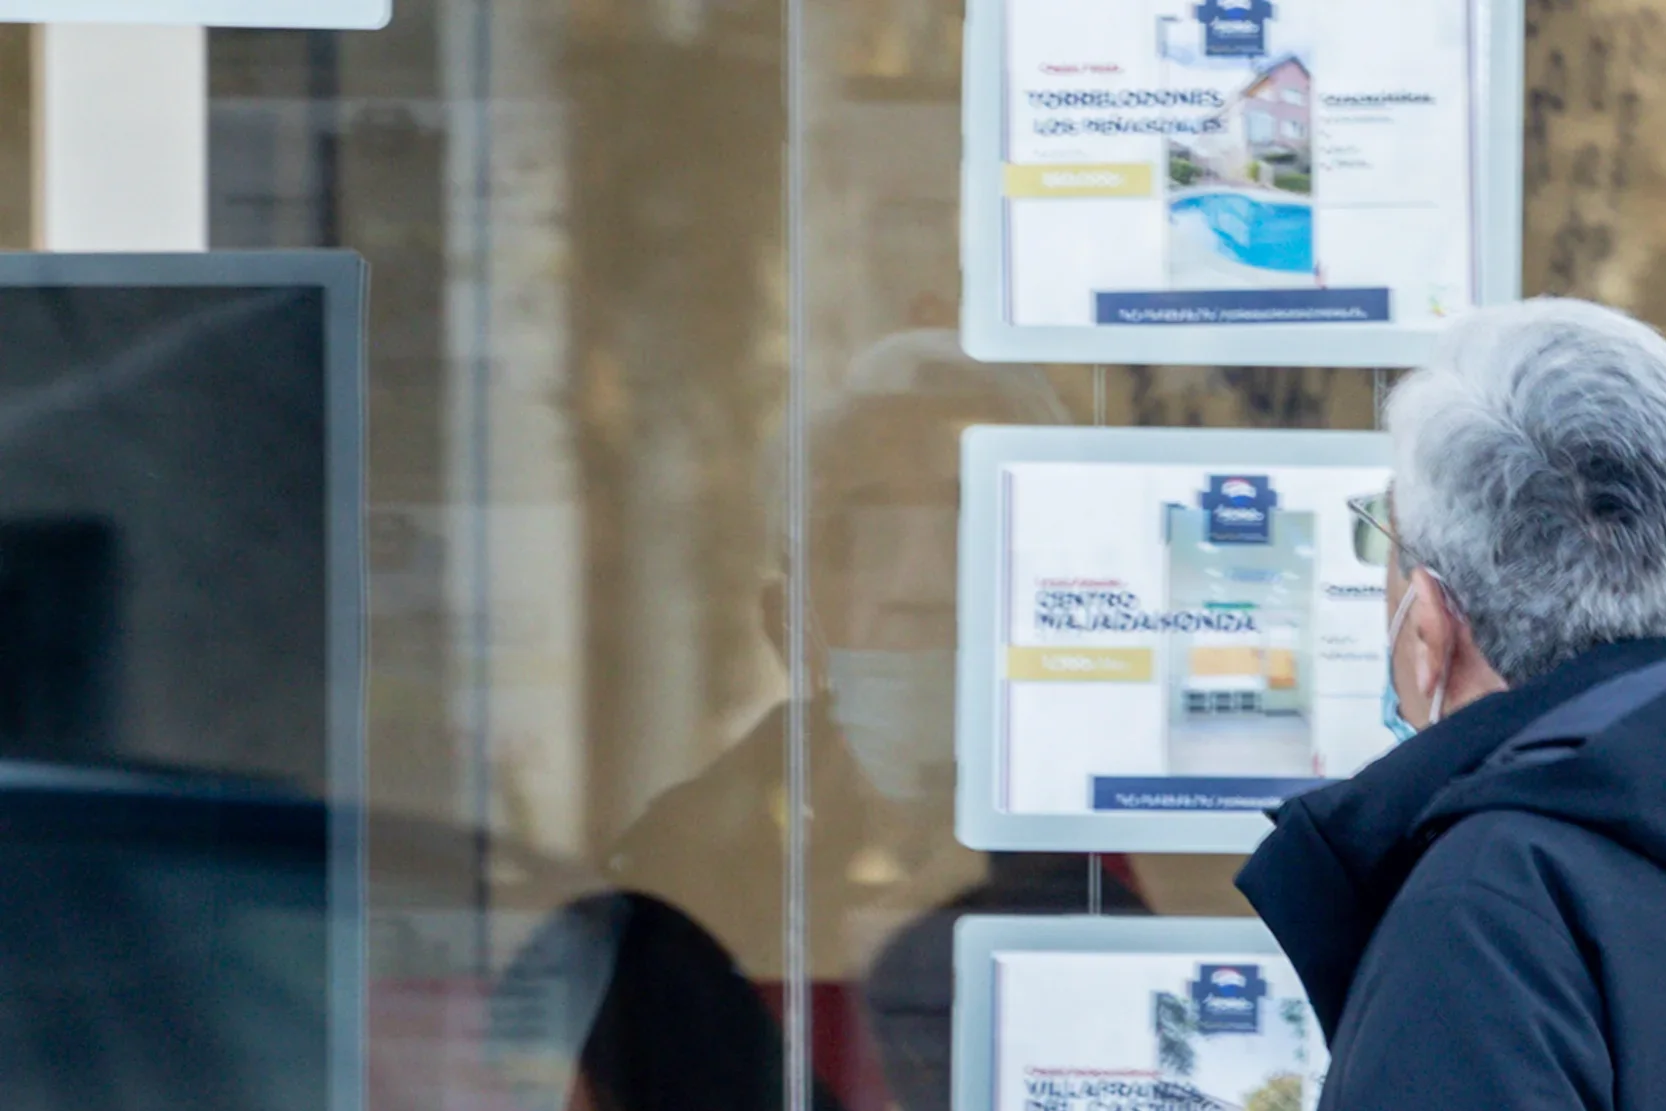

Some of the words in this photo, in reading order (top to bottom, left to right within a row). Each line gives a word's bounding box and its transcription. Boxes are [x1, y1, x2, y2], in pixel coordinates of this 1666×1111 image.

[1025, 88, 1225, 110] TORRELODONES
[1035, 590, 1139, 609] CENTRO
[1035, 610, 1260, 632] MAJADAHONDA
